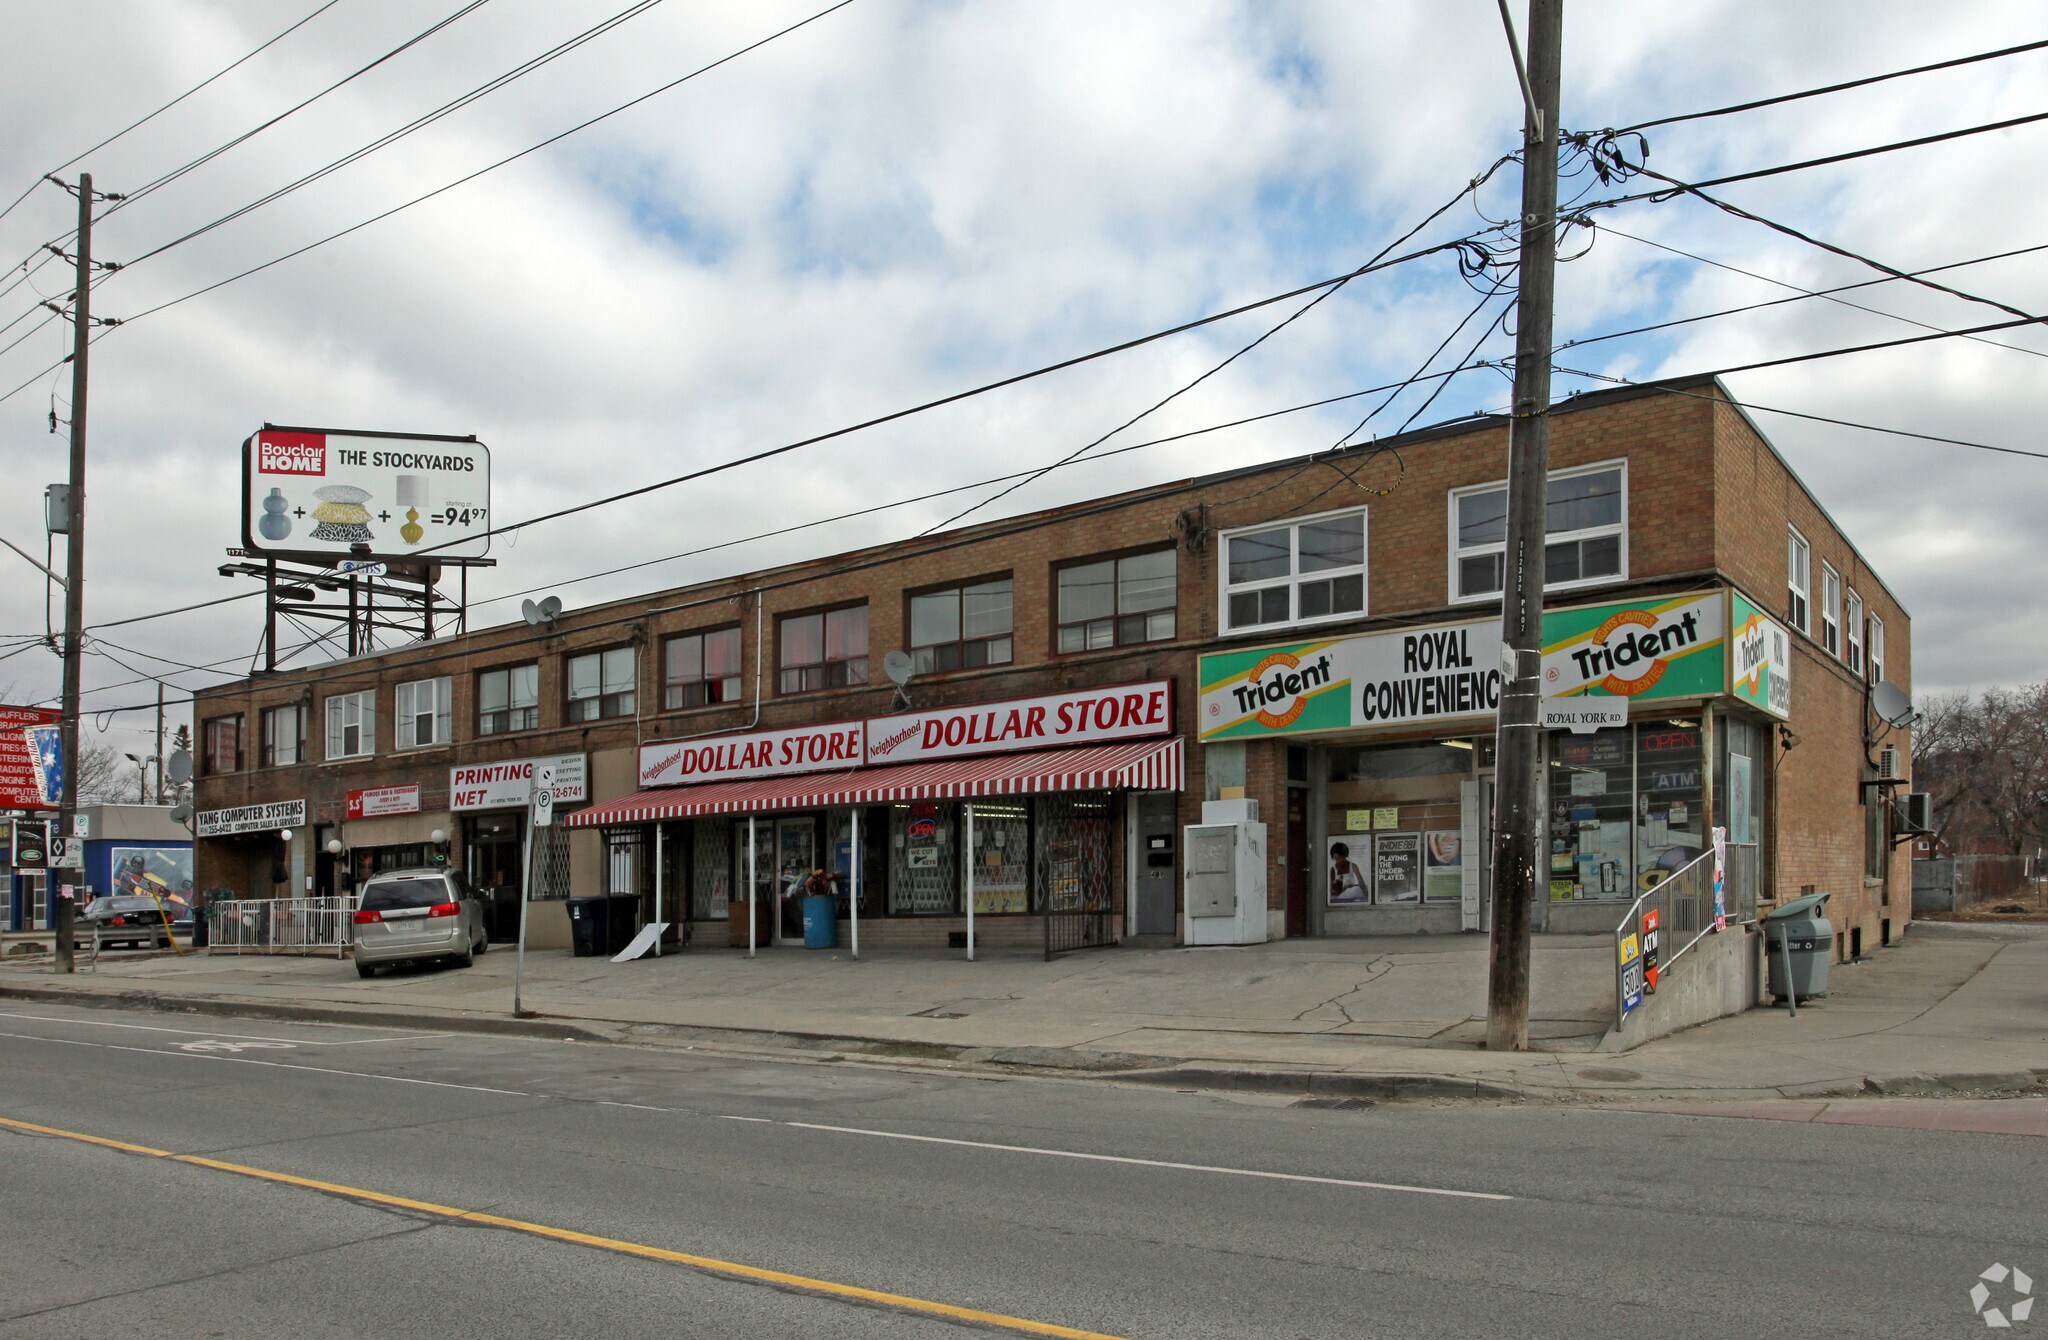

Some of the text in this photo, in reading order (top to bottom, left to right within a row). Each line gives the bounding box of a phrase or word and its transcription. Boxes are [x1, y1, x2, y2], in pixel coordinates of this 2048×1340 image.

[262, 442, 324, 458] Bouclair
[338, 450, 474, 472] THE STOCKYARDS
[262, 456, 322, 472] HOME
[356, 562, 381, 574] CBS
[1594, 610, 1655, 644] FIGHTS CAVITIES
[1404, 630, 1472, 673] ROYAL
[1572, 612, 1698, 680] Trident
[1742, 629, 1764, 672] Trident
[1250, 653, 1299, 682] FIGHTS CAVITIES
[1233, 656, 1330, 714] Trident
[1362, 669, 1500, 720] CONVENIENC
[1606, 677, 1629, 693] WITH
[870, 690, 1165, 758] Neighborhood DOLLAR STORE
[1258, 710, 1278, 726] WITH
[1546, 712, 1577, 724] ROYAL
[1580, 712, 1608, 723] YORK
[1645, 733, 1696, 751] OPEN
[642, 730, 860, 782] Neighborhood DOLLAR STORE
[454, 763, 533, 786] PRINTING
[1658, 772, 1695, 787] ATM
[454, 790, 488, 806] NET
[198, 801, 303, 825] YANG COMPUTER SYSTEMS
[909, 823, 935, 835] OPEN
[1643, 930, 1658, 954] ATM
